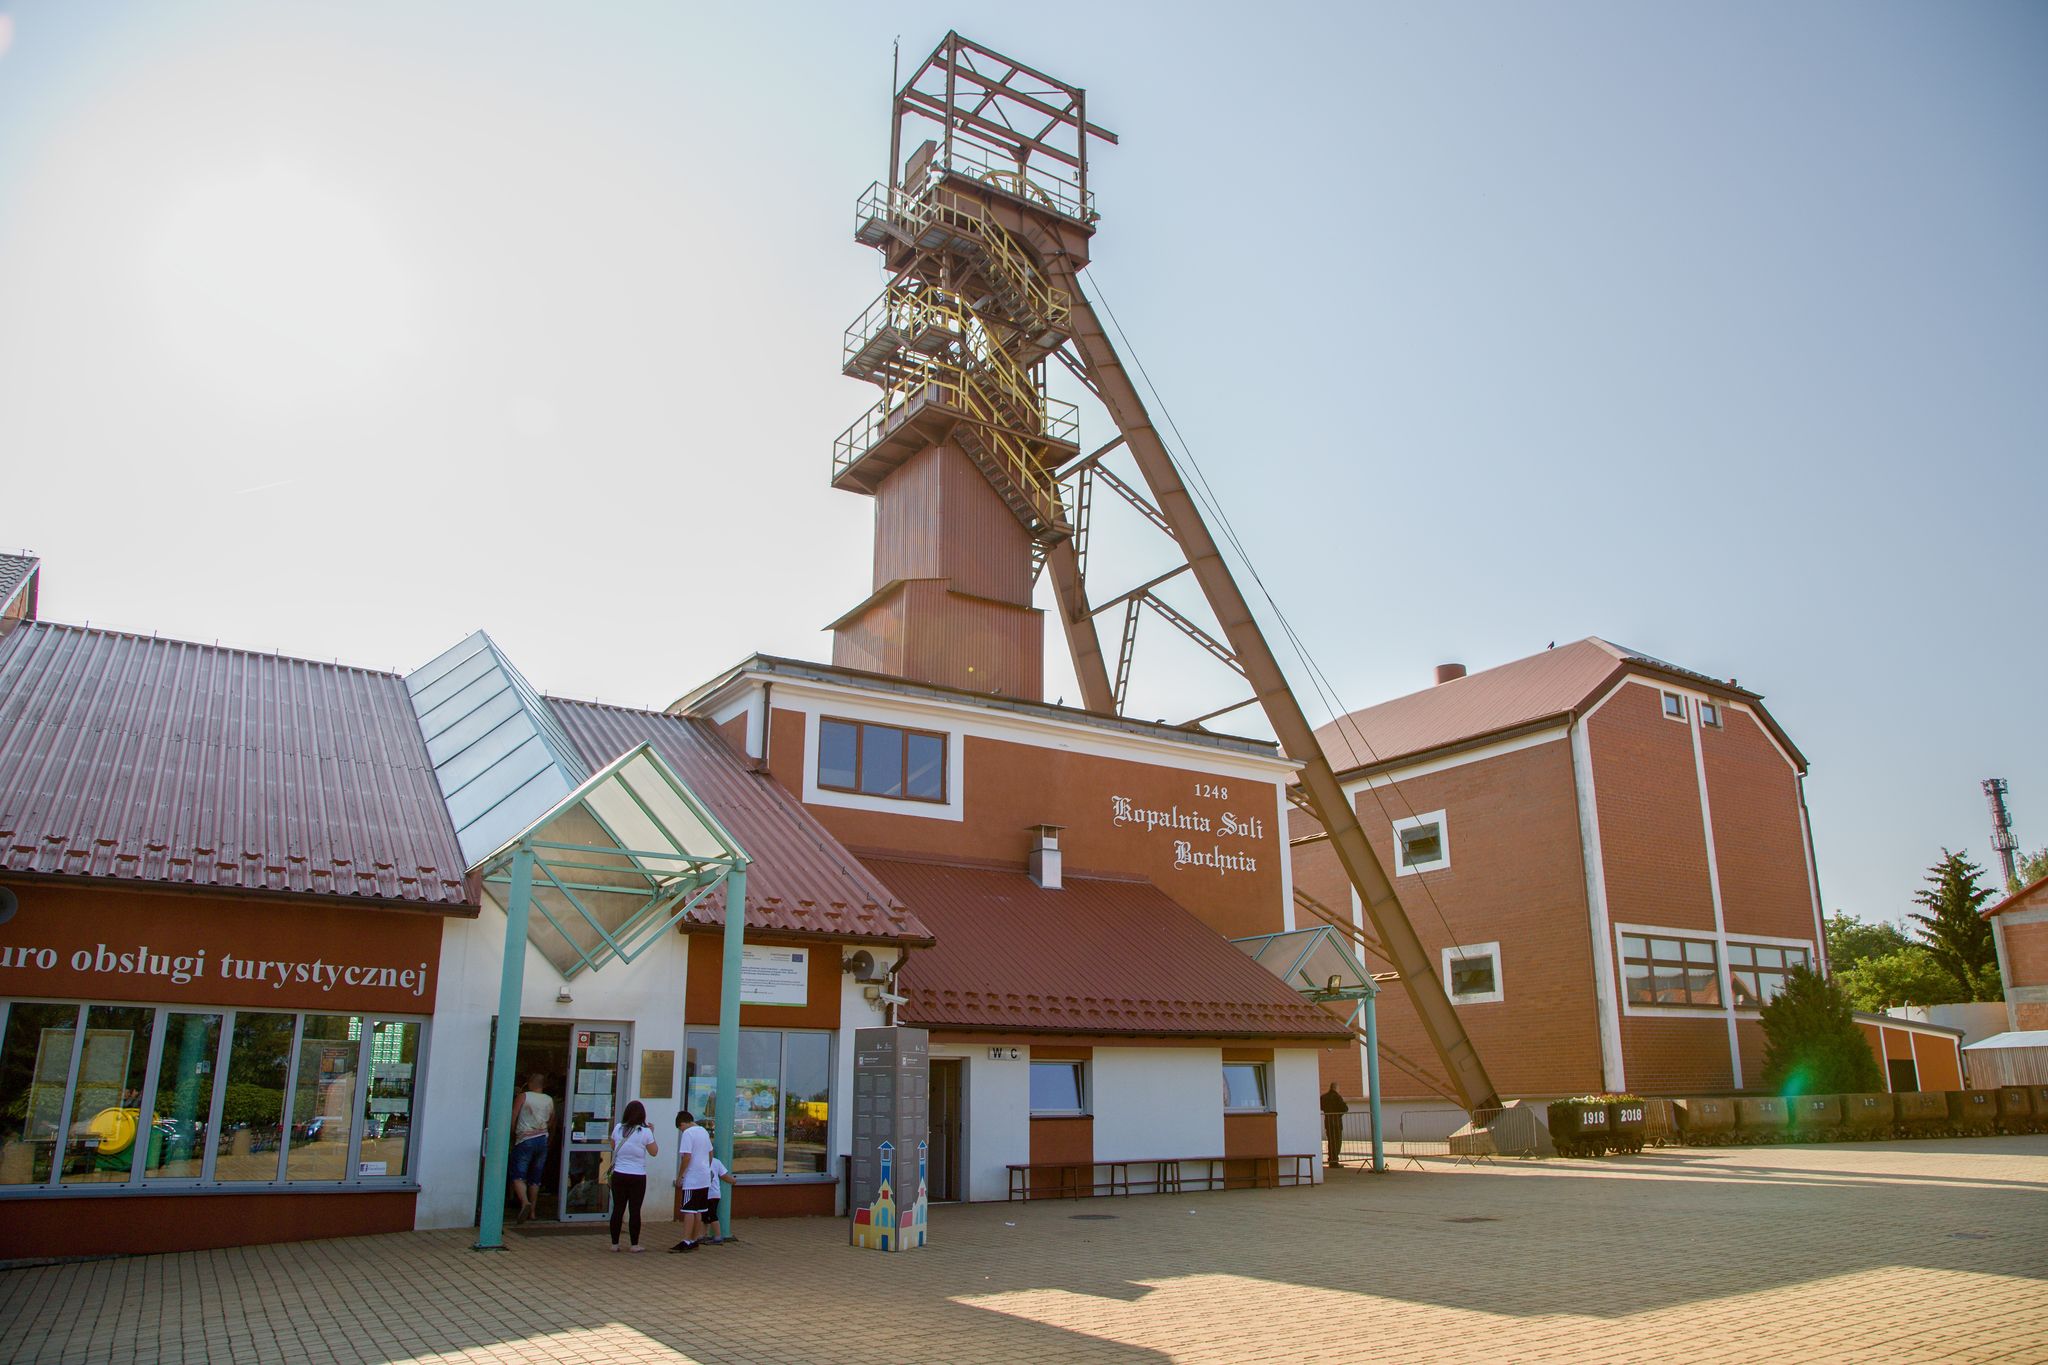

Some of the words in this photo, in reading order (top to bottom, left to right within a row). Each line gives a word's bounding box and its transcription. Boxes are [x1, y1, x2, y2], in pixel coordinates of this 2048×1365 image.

[1194, 784, 1228, 800] 1248
[1111, 795, 1211, 832] Kopalnia
[1216, 811, 1264, 839] Soli
[1173, 840, 1257, 876] Bochnia
[72, 943, 205, 984] obsługi
[220, 951, 427, 995] turystycznej
[1583, 1111, 1605, 1125] 1918
[1621, 1109, 1642, 1122] 2018
